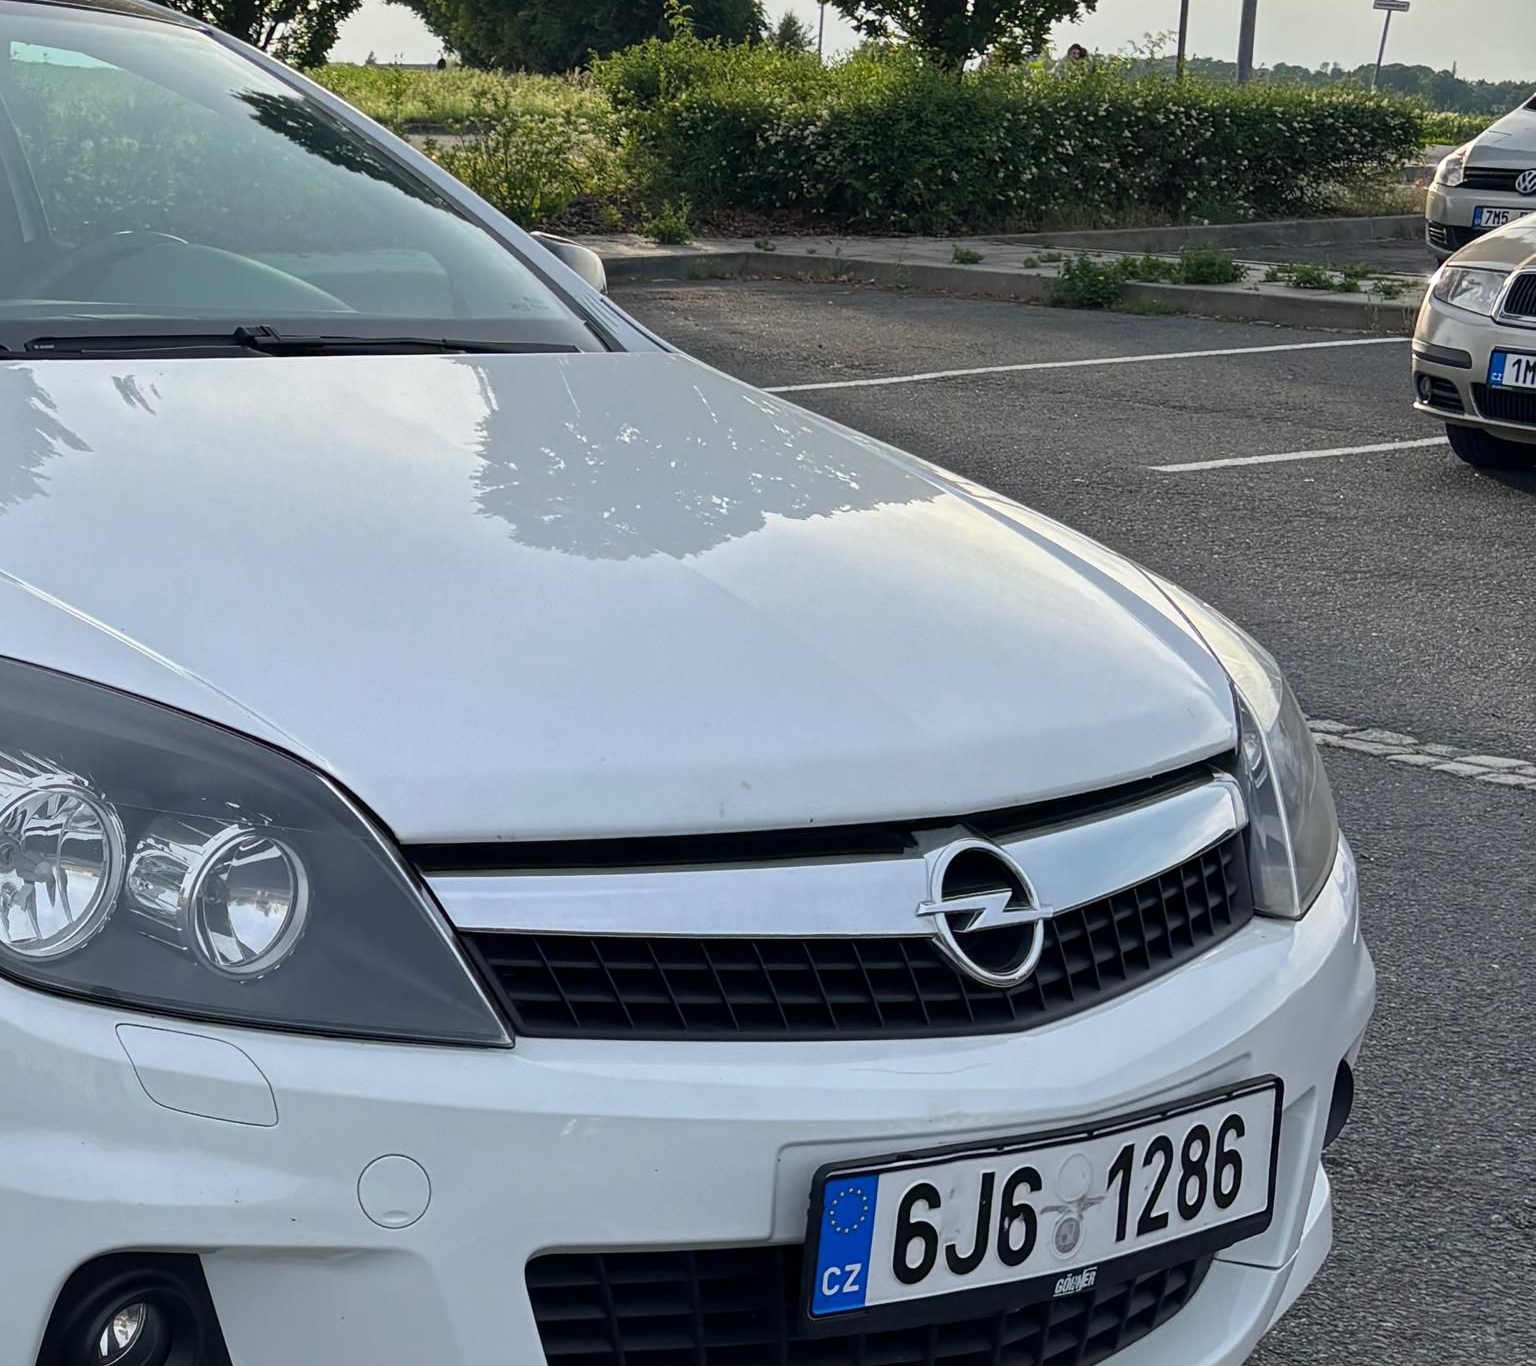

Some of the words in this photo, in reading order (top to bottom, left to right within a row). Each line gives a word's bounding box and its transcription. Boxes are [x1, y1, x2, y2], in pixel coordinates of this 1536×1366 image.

[892, 1166, 1043, 1285] 6J6
[1106, 1113, 1245, 1243] 1286
[821, 1262, 862, 1296] CZ
